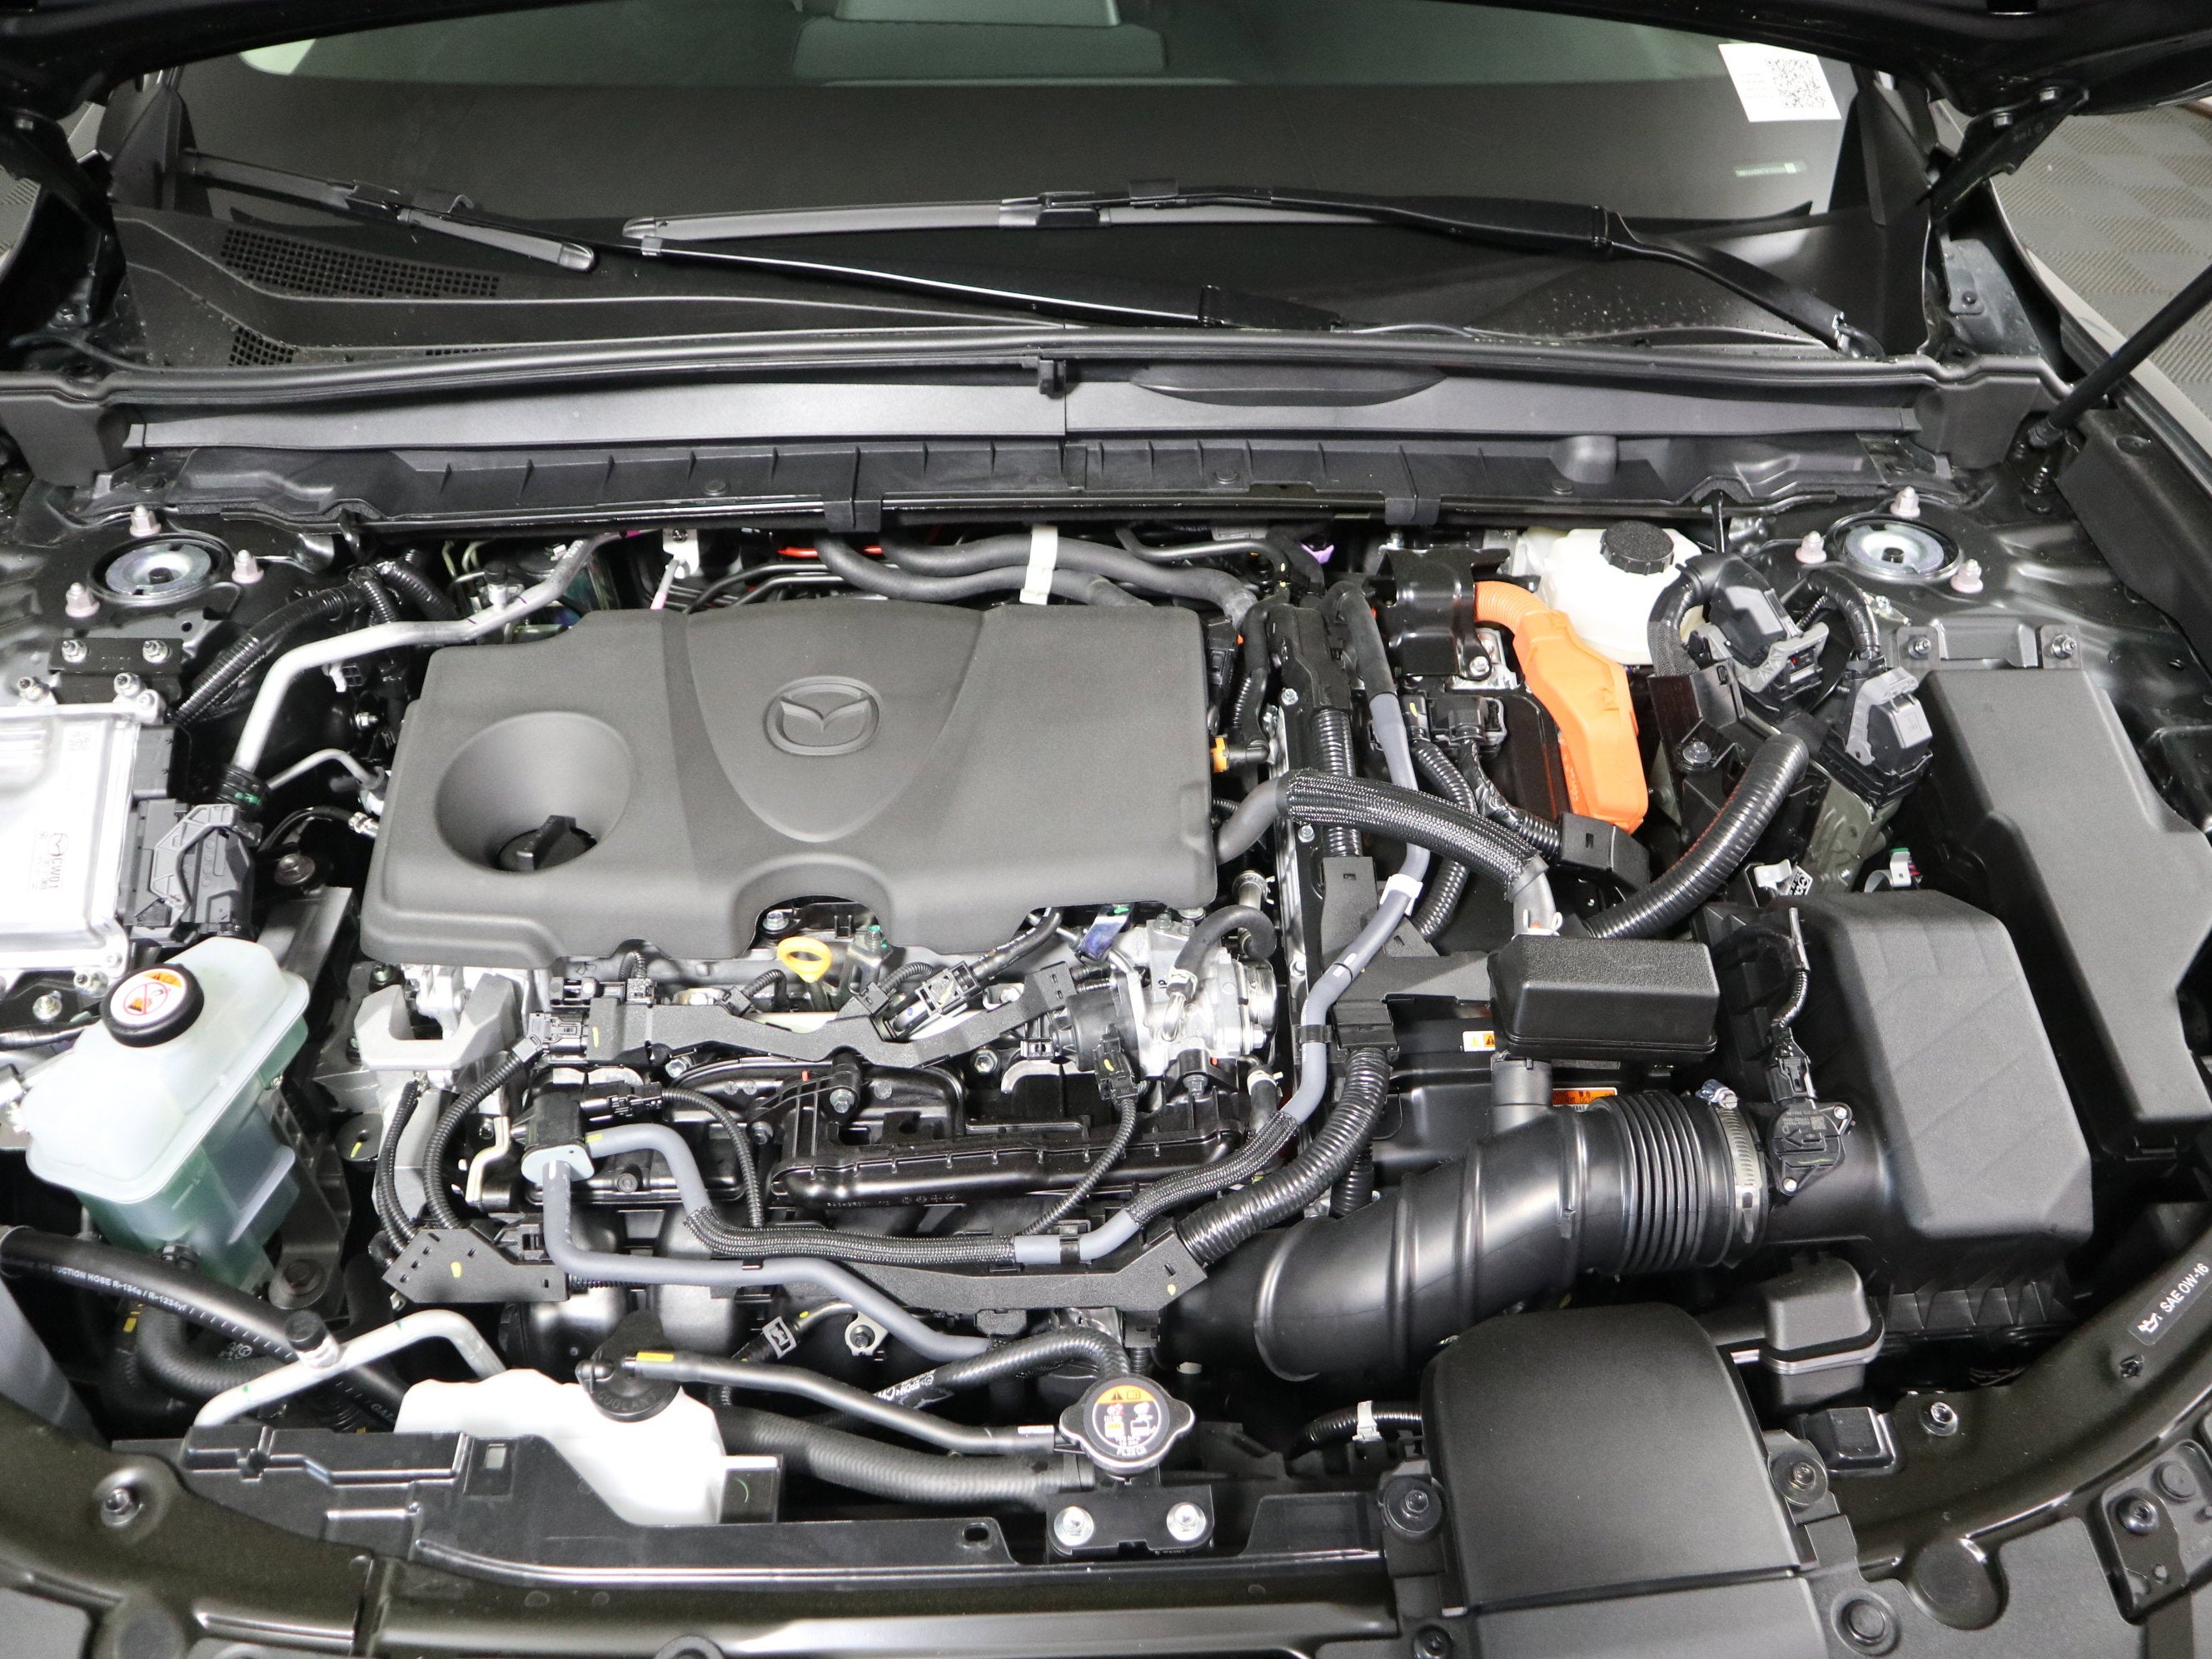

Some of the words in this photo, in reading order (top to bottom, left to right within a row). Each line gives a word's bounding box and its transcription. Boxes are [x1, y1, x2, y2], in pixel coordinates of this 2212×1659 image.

[52, 1265, 87, 1281] SUCTION
[87, 1273, 112, 1286] HOSE
[2160, 1289, 2185, 1313] SAE
[2178, 1263, 2210, 1293] 0W-16
[597, 1389, 659, 1412] COOLANT
